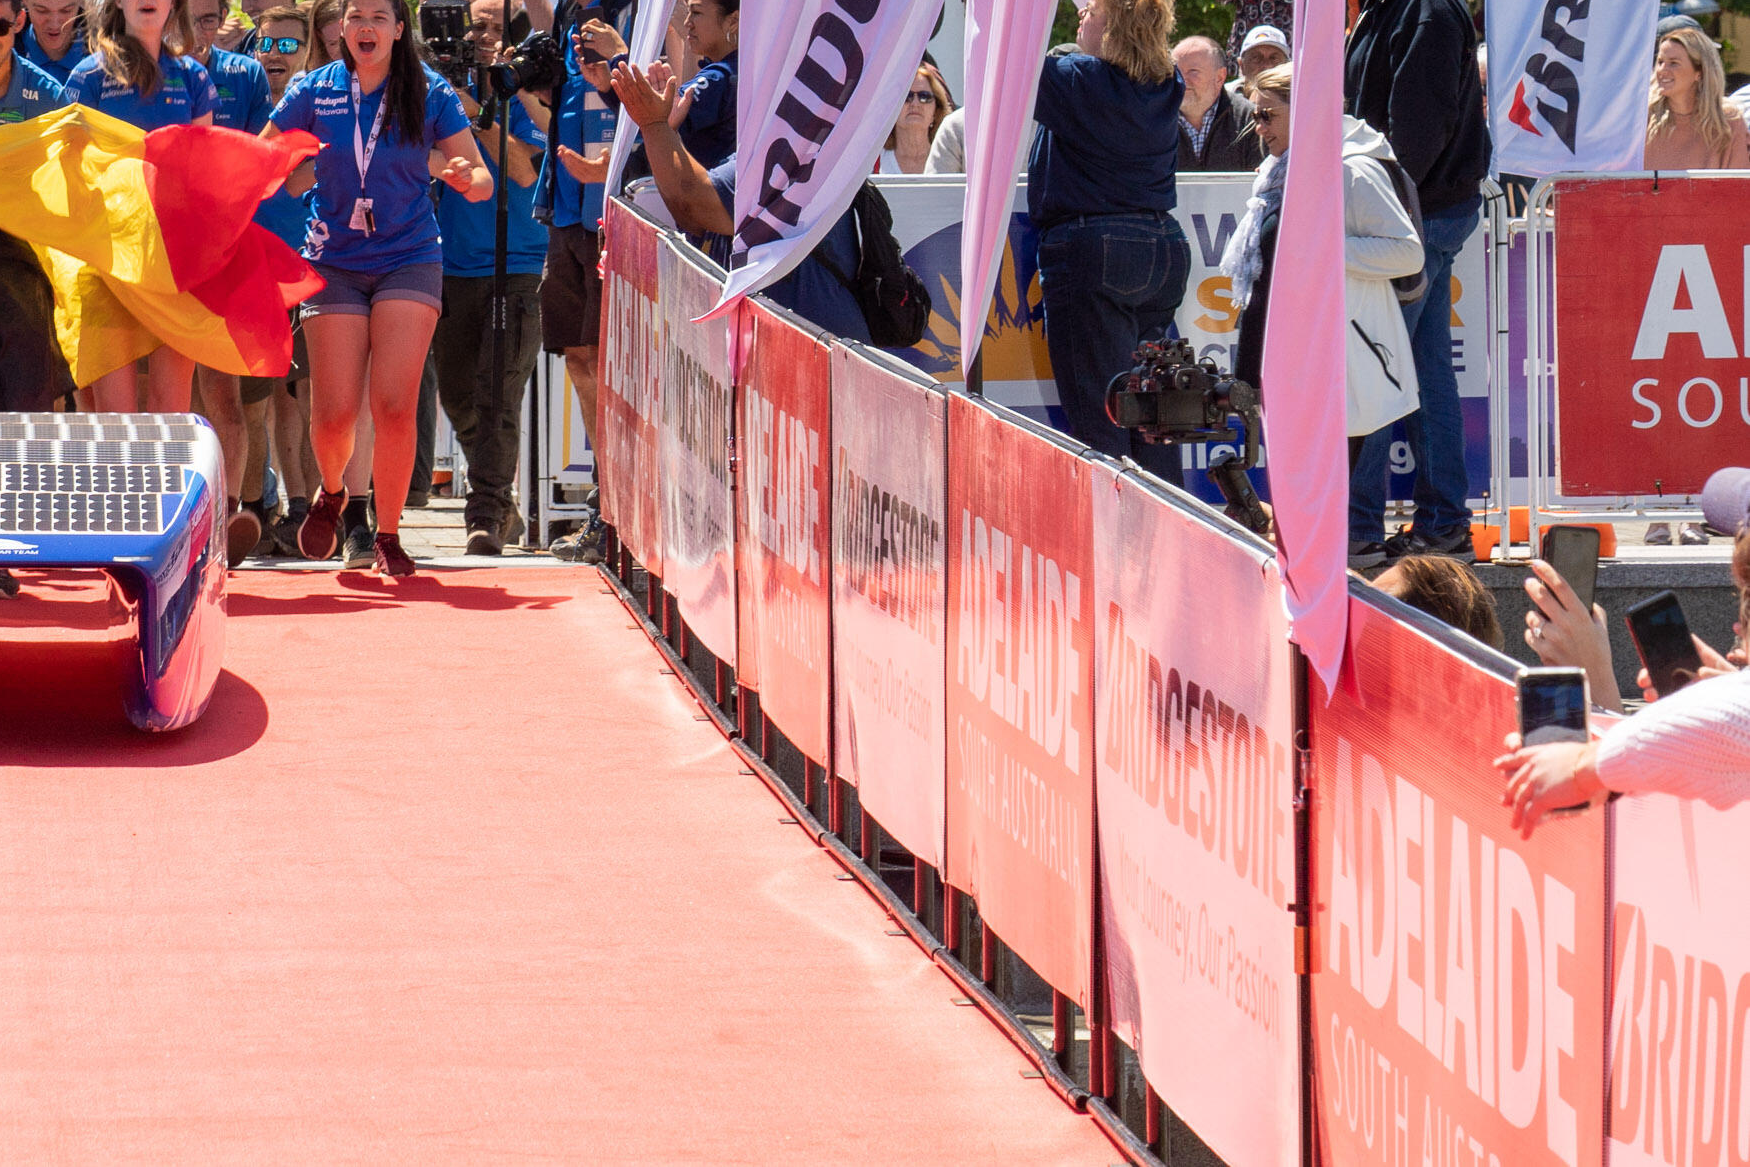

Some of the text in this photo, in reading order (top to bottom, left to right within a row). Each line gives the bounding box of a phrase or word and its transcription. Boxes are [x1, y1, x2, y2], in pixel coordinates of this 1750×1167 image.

[957, 508, 1080, 776] ADELAIDE
[957, 714, 997, 822] SOUTH
[1105, 600, 1285, 912] BRIDGESTONE
[1196, 898, 1224, 976] Our
[1226, 926, 1280, 1042] Passion
[1329, 736, 1578, 1167] ADELAIDE
[1330, 1012, 1409, 1162] SOUTH
